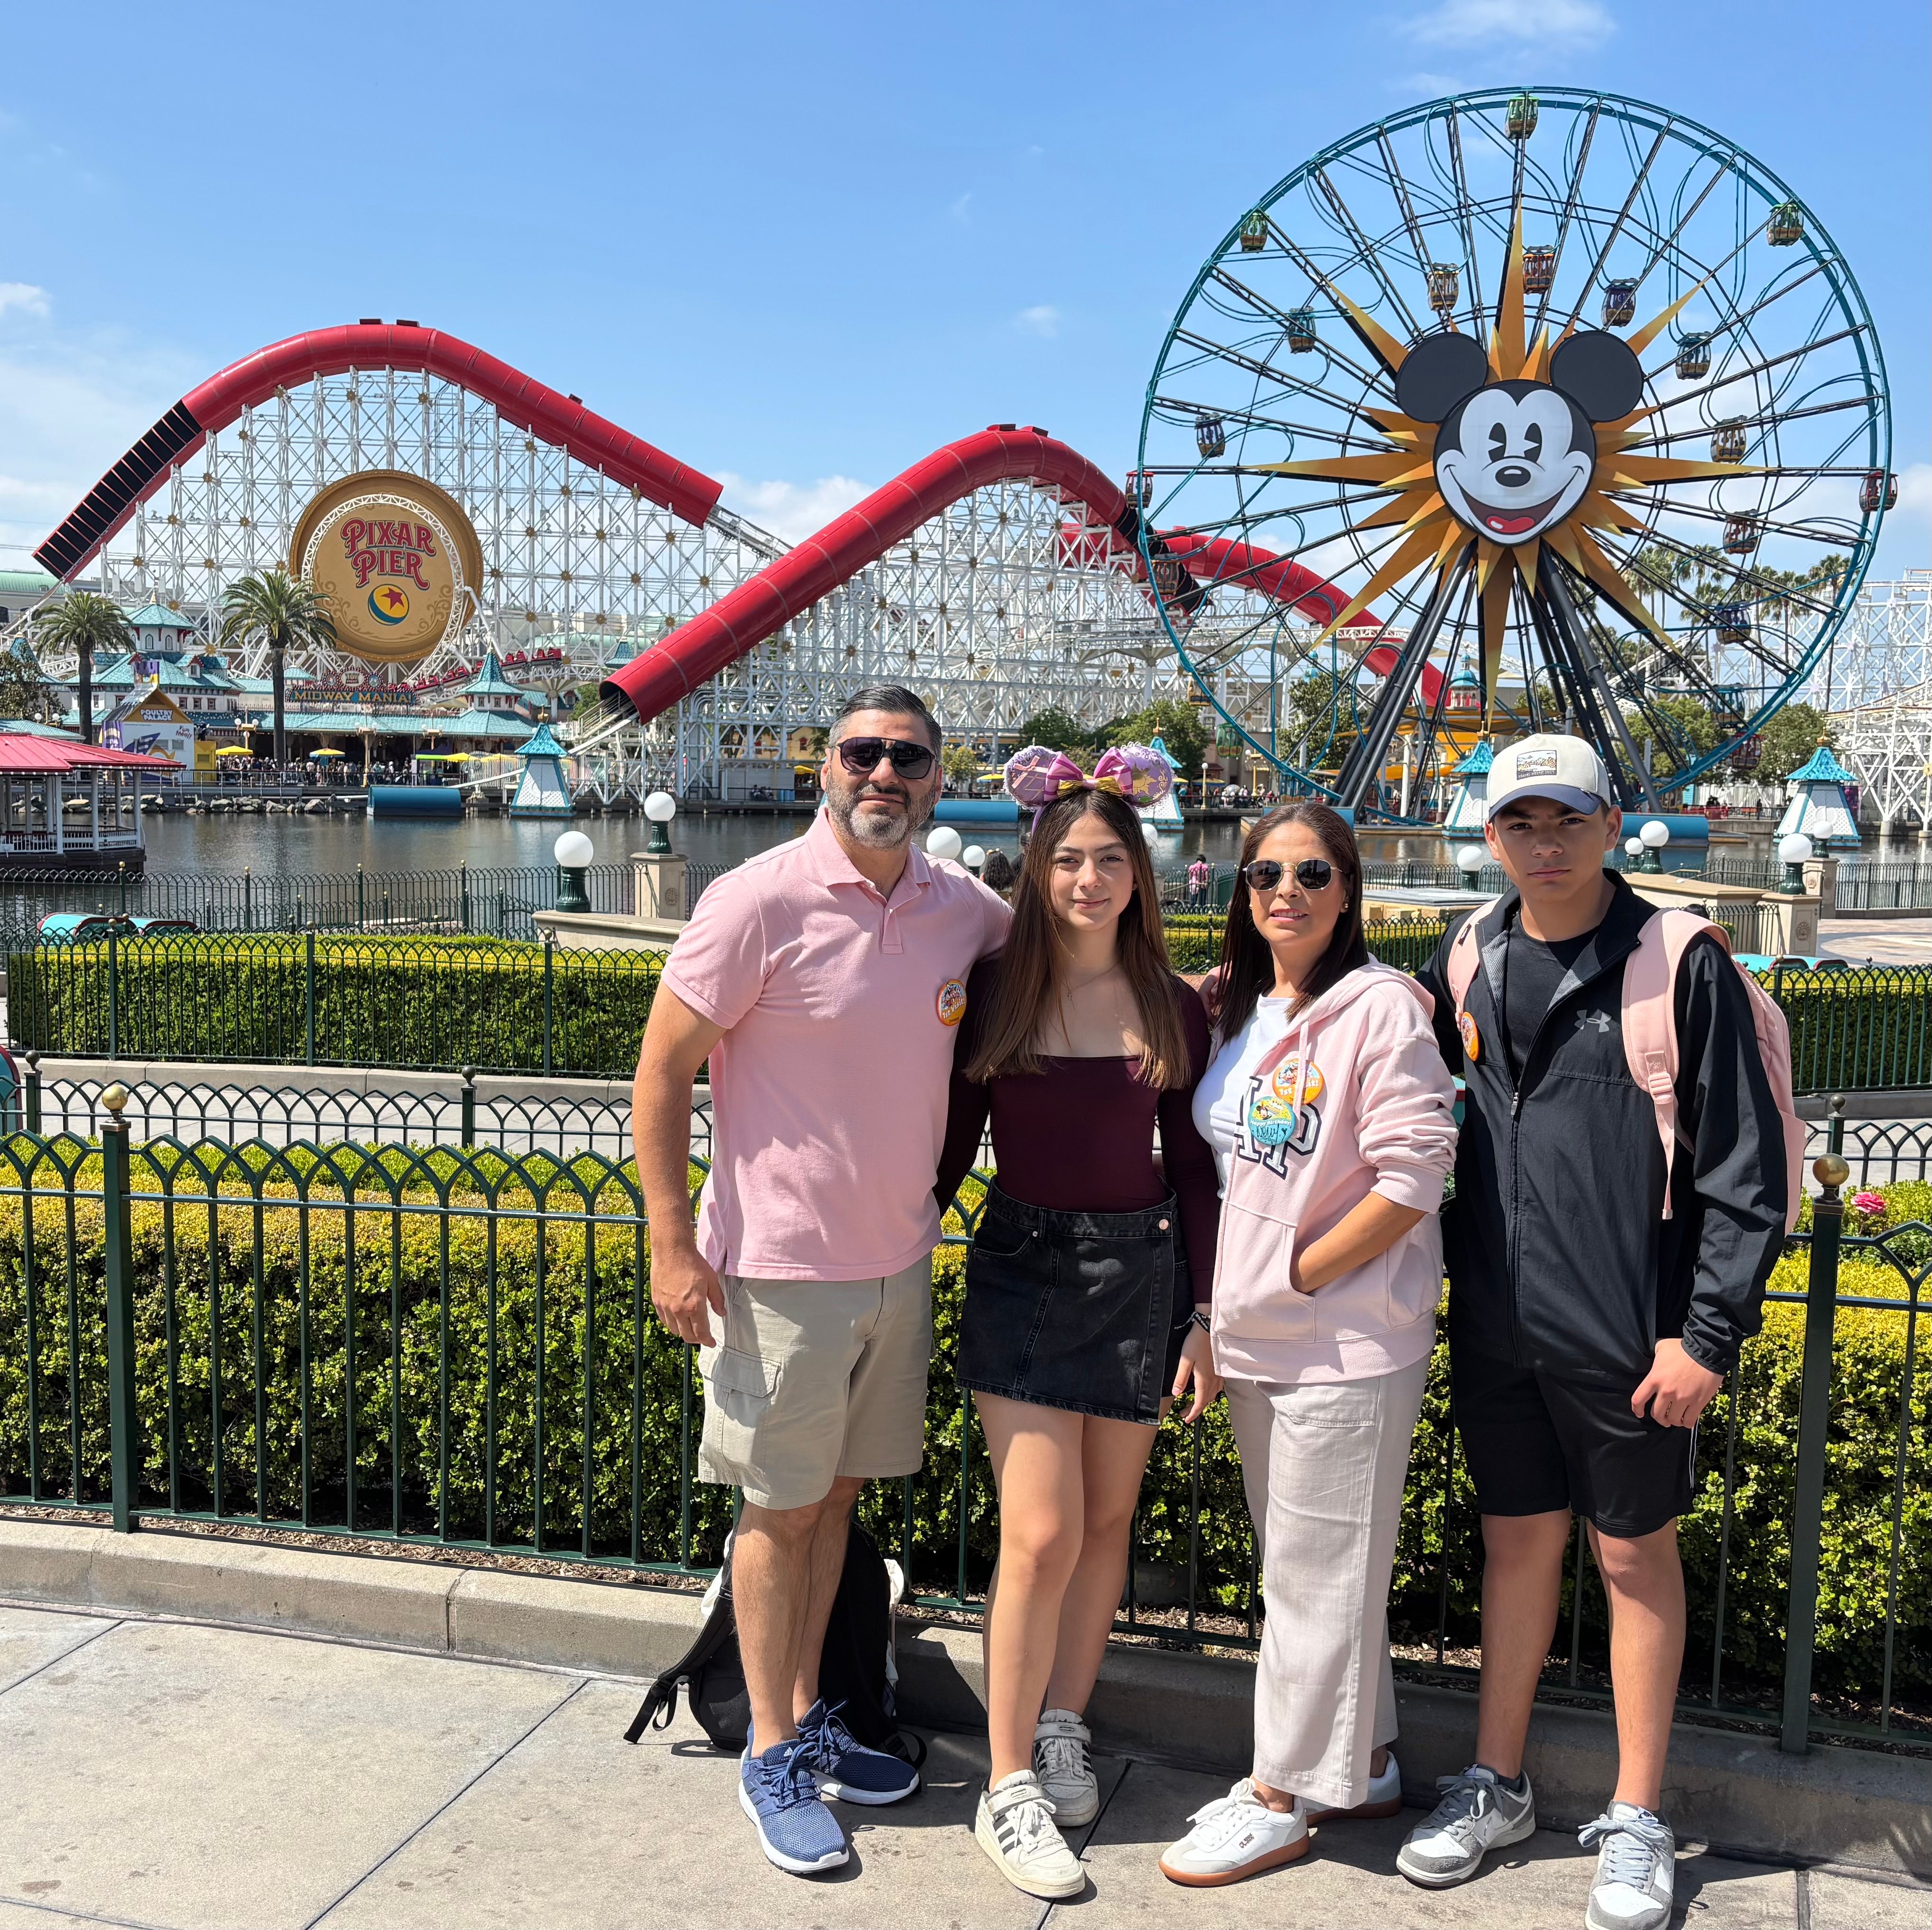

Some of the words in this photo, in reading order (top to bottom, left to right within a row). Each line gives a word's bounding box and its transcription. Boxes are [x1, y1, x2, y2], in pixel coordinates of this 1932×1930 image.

[341, 517, 437, 559] PIXAR
[351, 549, 430, 591] PIER
[295, 691, 354, 701] MIDWAY
[358, 692, 412, 703] MANIA!
[942, 1010, 951, 1019] 1st
[951, 997, 965, 1012] Visit!
[1279, 1087, 1292, 1096] 1st
[1250, 1119, 1266, 1128] Happy
